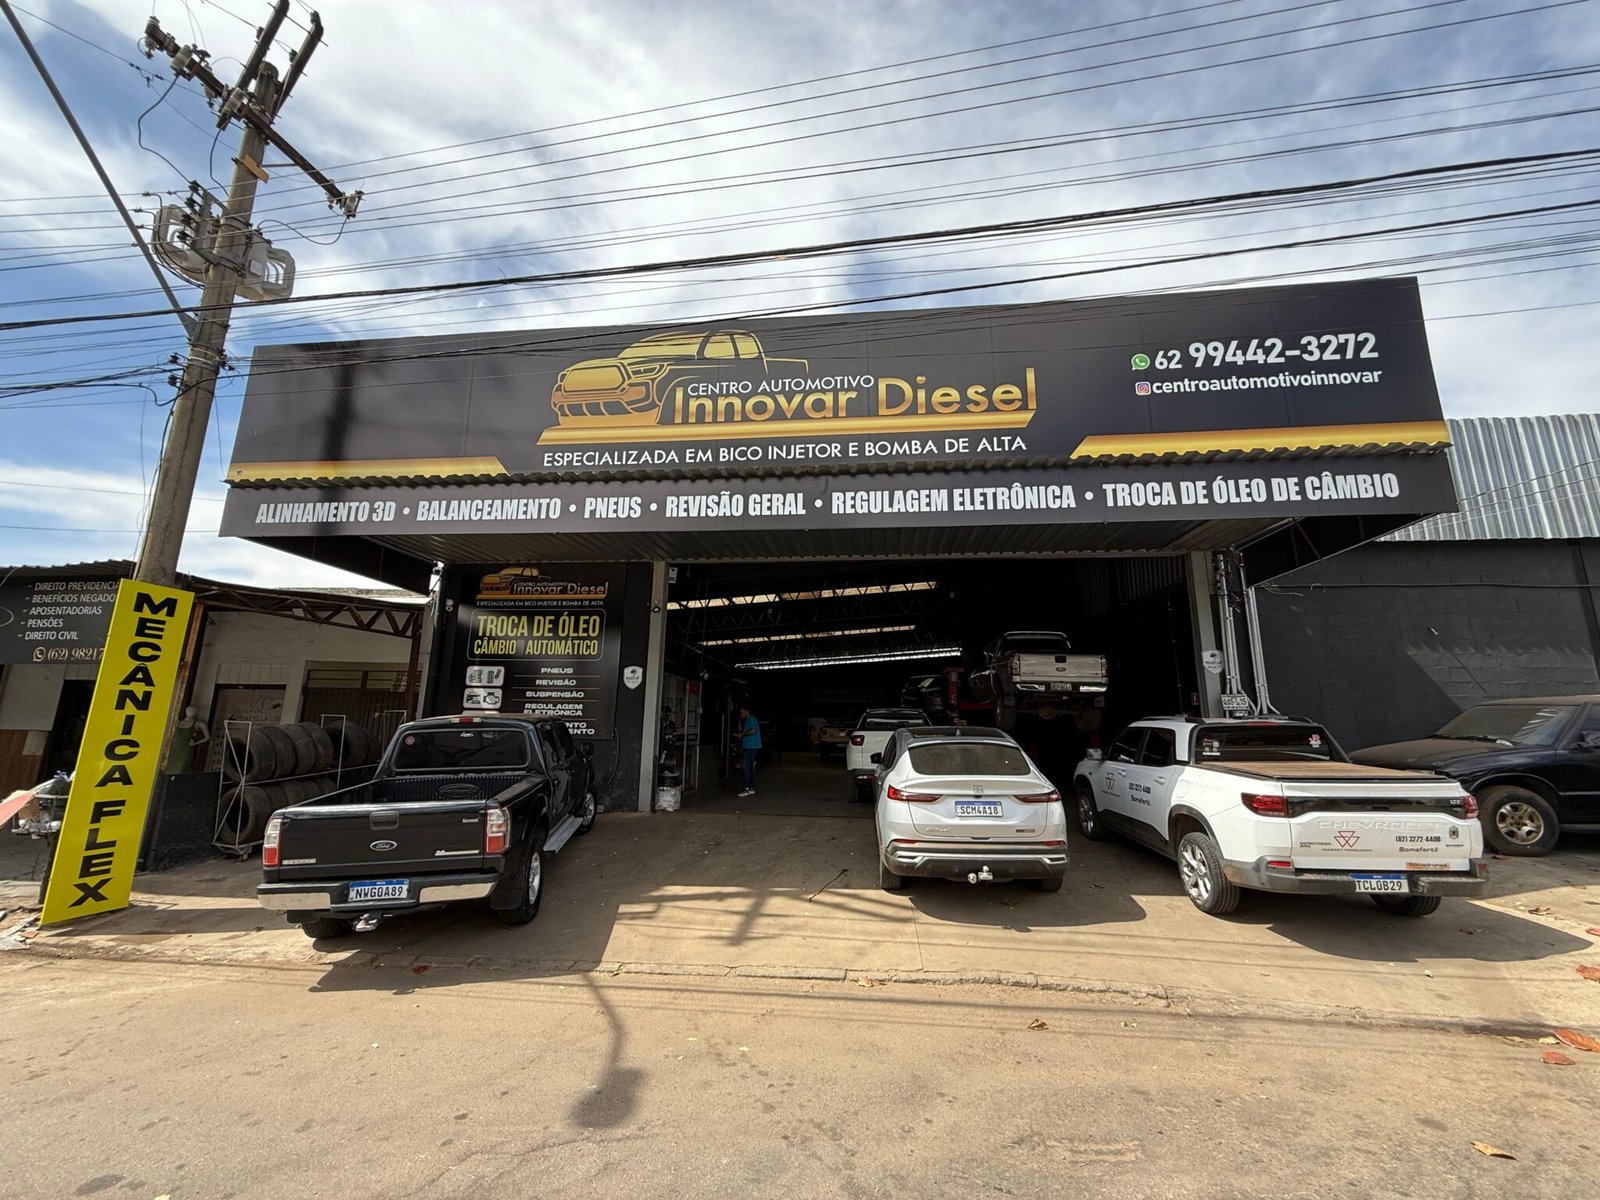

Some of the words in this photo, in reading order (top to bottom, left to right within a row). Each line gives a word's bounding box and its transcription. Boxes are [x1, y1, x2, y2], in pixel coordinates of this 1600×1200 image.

[1154, 350, 1182, 370] 62
[1188, 332, 1379, 368] 99442-3272
[687, 380, 752, 396] CENTRO
[758, 375, 875, 393] AUTOMOTIVO
[1152, 370, 1382, 394] centroautomotivoinnovar
[674, 386, 858, 424] Innovar
[878, 367, 1037, 416] Diesel
[543, 450, 680, 466] ESPECIALIZADA
[685, 449, 713, 463] EM
[719, 445, 763, 462] BICO
[768, 443, 842, 460] INJETOR
[848, 442, 858, 457] E
[865, 439, 938, 456] BOMBA
[945, 438, 969, 453] DE
[976, 436, 1027, 452] ALTA
[255, 501, 369, 523] ALINHAMENTO
[372, 501, 396, 522] 3D
[416, 498, 561, 521] BALANCEAMENTO
[584, 496, 642, 519] PNEUS
[665, 490, 743, 518] REVISÃO
[748, 492, 806, 516] GERAL
[831, 489, 948, 514] REGULAGEM
[953, 482, 1076, 511] ELETRÔNICA
[1102, 481, 1177, 507] TROCA
[1180, 480, 1209, 505] DE
[1212, 475, 1267, 504] ÓLEO
[1271, 477, 1301, 502] DE
[1304, 471, 1400, 500] CÂMBIO
[34, 582, 66, 591] DIREITO
[513, 583, 563, 595] Innovar
[567, 581, 609, 595] Diesel
[32, 592, 78, 603] BENEFÍCIOS
[80, 593, 117, 602] NEGADO
[29, 606, 102, 615] APOSENTADORIAS
[27, 617, 64, 628] PENSÕES
[477, 615, 528, 637] TROCA
[532, 615, 555, 637] DE
[558, 611, 600, 637] ÓLEO
[25, 631, 57, 640] DIREITO
[58, 631, 79, 640] CIVIL
[473, 637, 517, 655] CÂMBIO
[525, 638, 598, 655] AUTOMÁTICO
[47, 647, 69, 661] (62)
[70, 647, 104, 661] 98217
[95, 591, 178, 788] MECÂNICA
[525, 690, 585, 698] SUSPENSÃO
[960, 806, 999, 815] SCM4A18
[1395, 835, 1409, 843] (62)
[67, 799, 126, 908] FLEX
[355, 886, 403, 899] NWG0A89
[1356, 880, 1402, 892] TCL0B29
